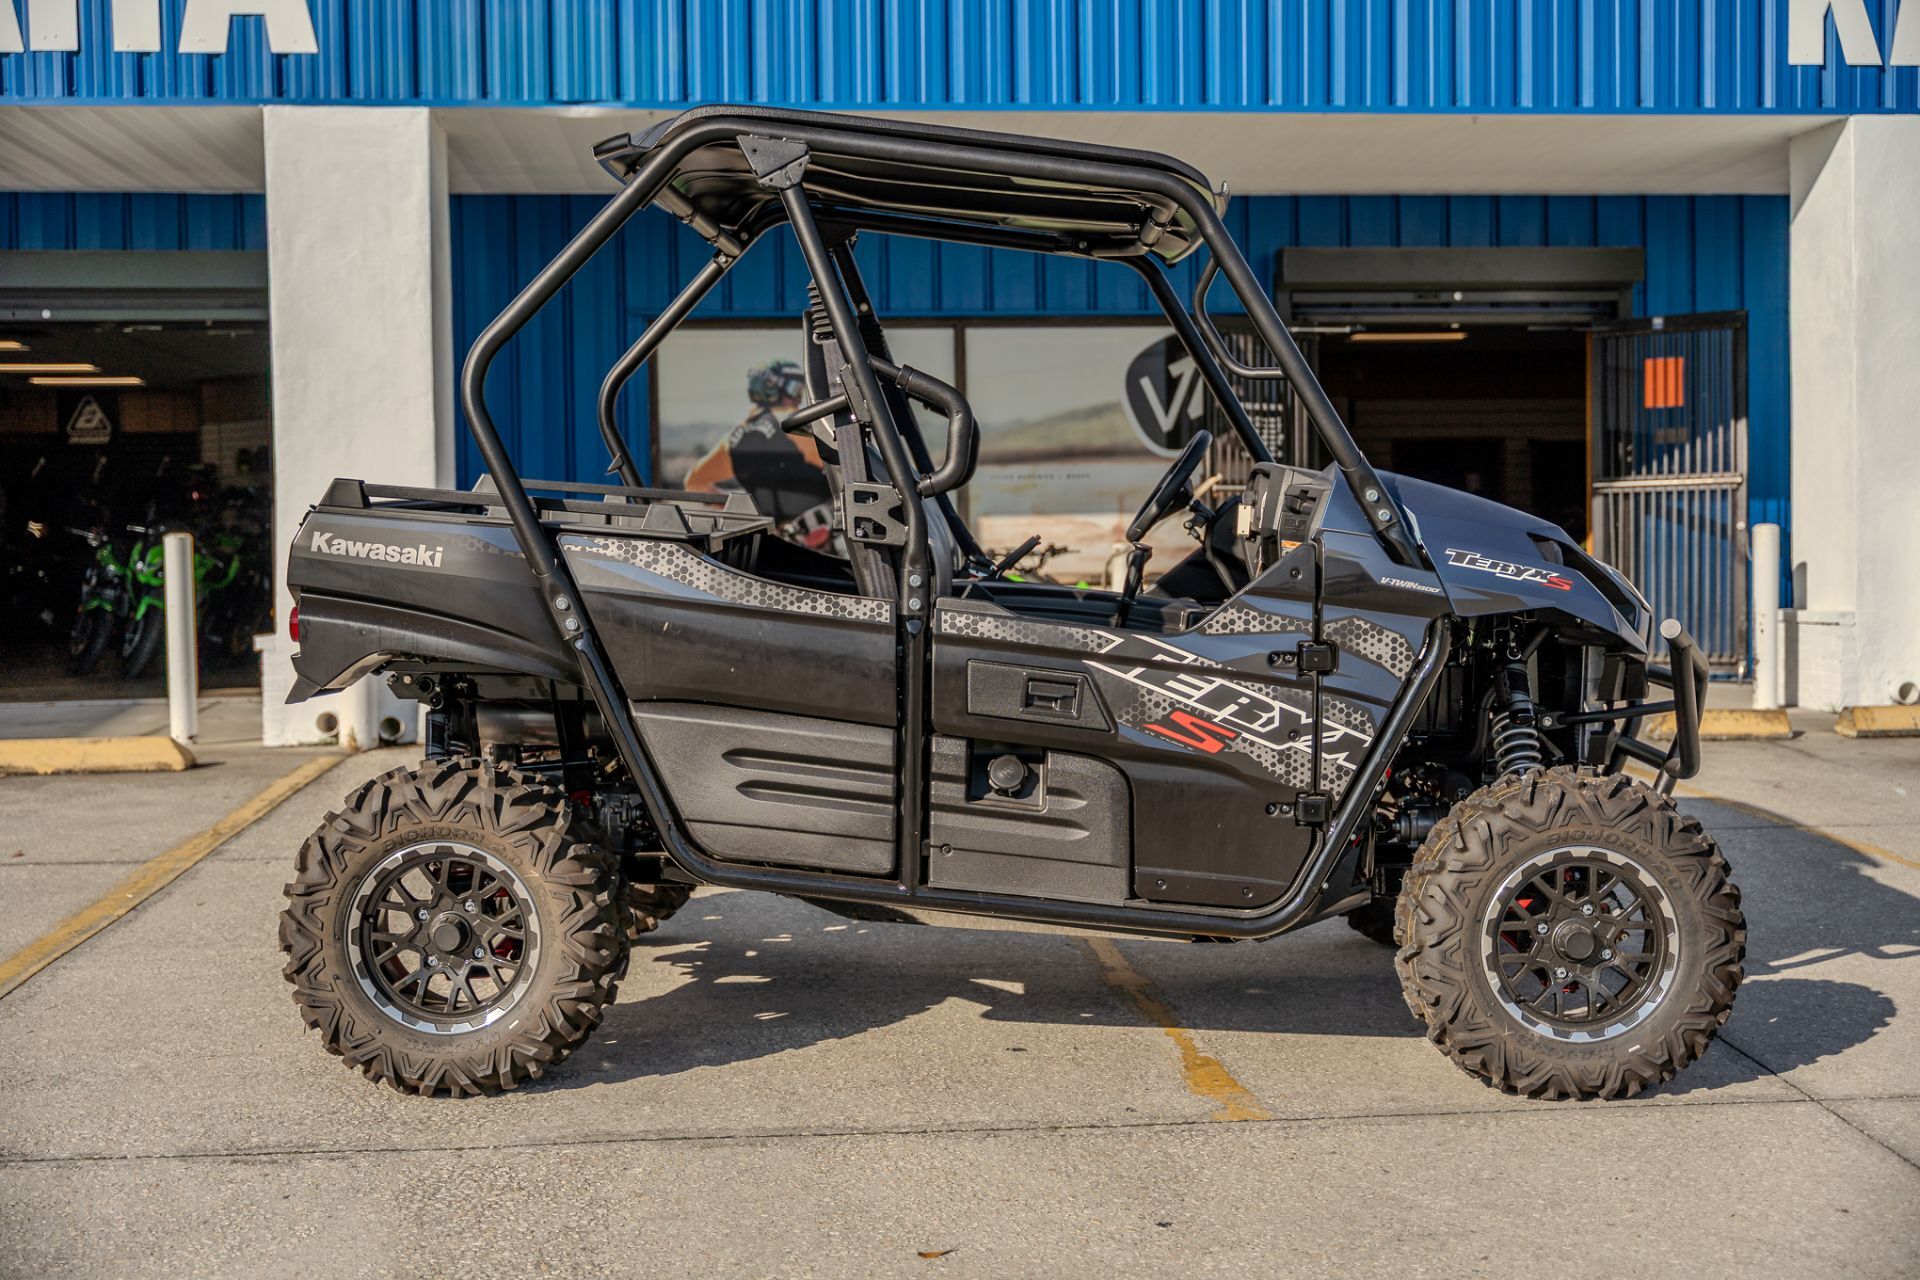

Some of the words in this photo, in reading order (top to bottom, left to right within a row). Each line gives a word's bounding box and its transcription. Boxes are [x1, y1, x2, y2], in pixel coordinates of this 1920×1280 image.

[310, 531, 443, 568] Kawasaki
[1445, 548, 1560, 582] TERYX
[1142, 711, 1237, 754] S
[383, 826, 485, 851] BIGHORN
[1545, 829, 1652, 859] BIGHORN
